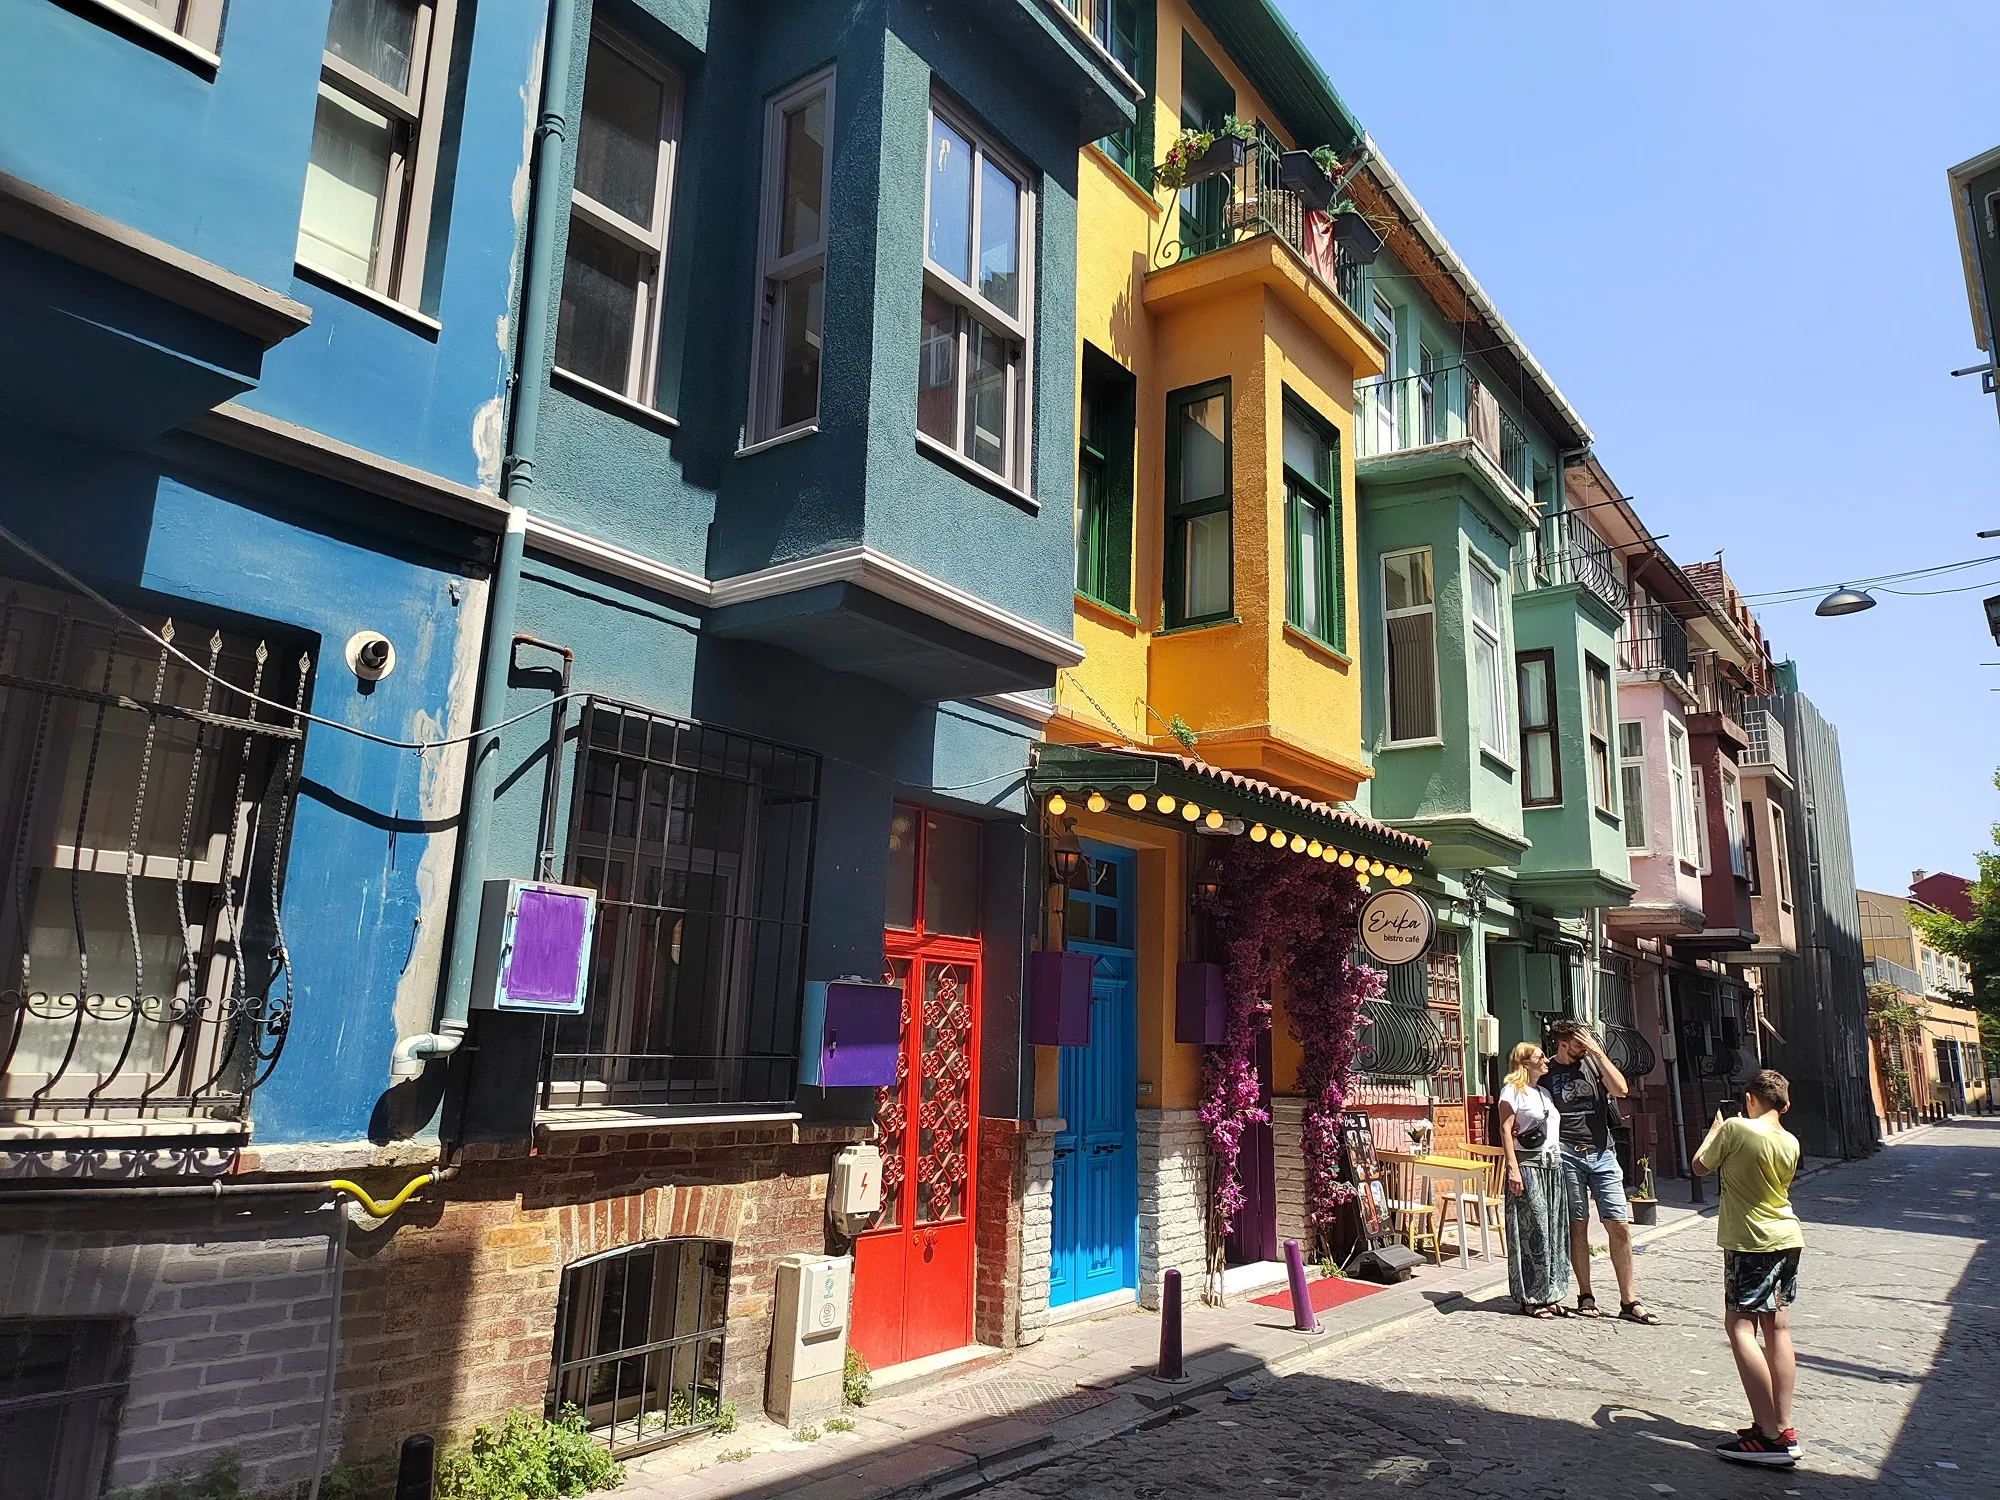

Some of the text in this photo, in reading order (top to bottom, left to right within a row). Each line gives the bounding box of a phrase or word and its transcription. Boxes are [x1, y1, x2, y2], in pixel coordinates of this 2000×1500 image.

[1368, 909, 1421, 933] Erika
[1383, 934, 1420, 943] bistro café
